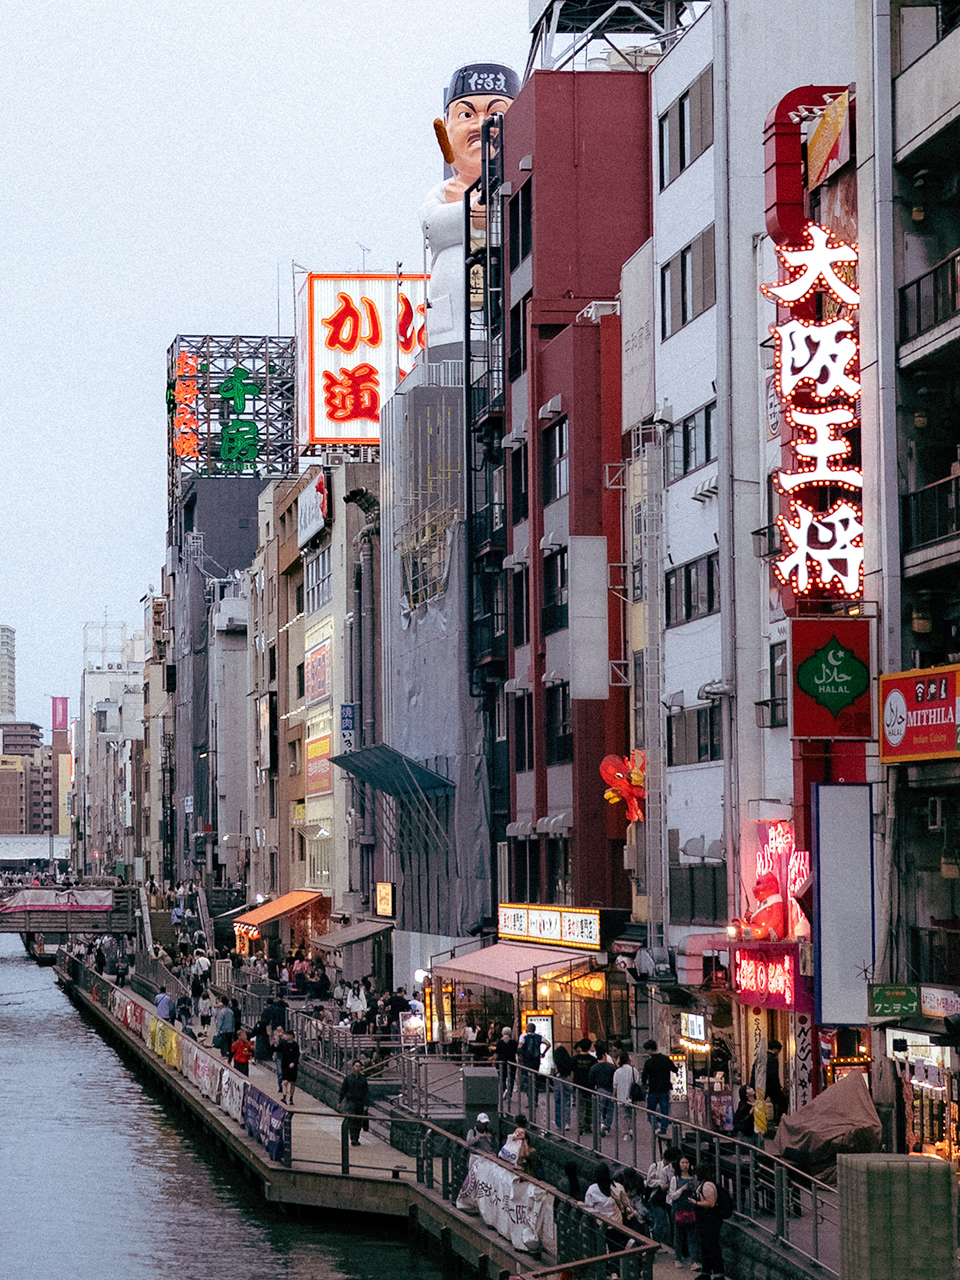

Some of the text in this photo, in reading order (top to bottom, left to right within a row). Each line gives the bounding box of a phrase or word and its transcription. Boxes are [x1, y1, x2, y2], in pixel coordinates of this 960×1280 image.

[468, 72, 507, 92] だるま
[172, 350, 200, 457] お好み焼
[322, 363, 407, 423] 道
[218, 367, 259, 460] 千房
[762, 223, 863, 598] 大阪王将
[814, 664, 852, 685] حلال
[818, 685, 850, 693] HALAL
[341, 707, 353, 729] 焼肉
[906, 706, 955, 727] MITHILA
[912, 732, 947, 745] Indian Cuisine
